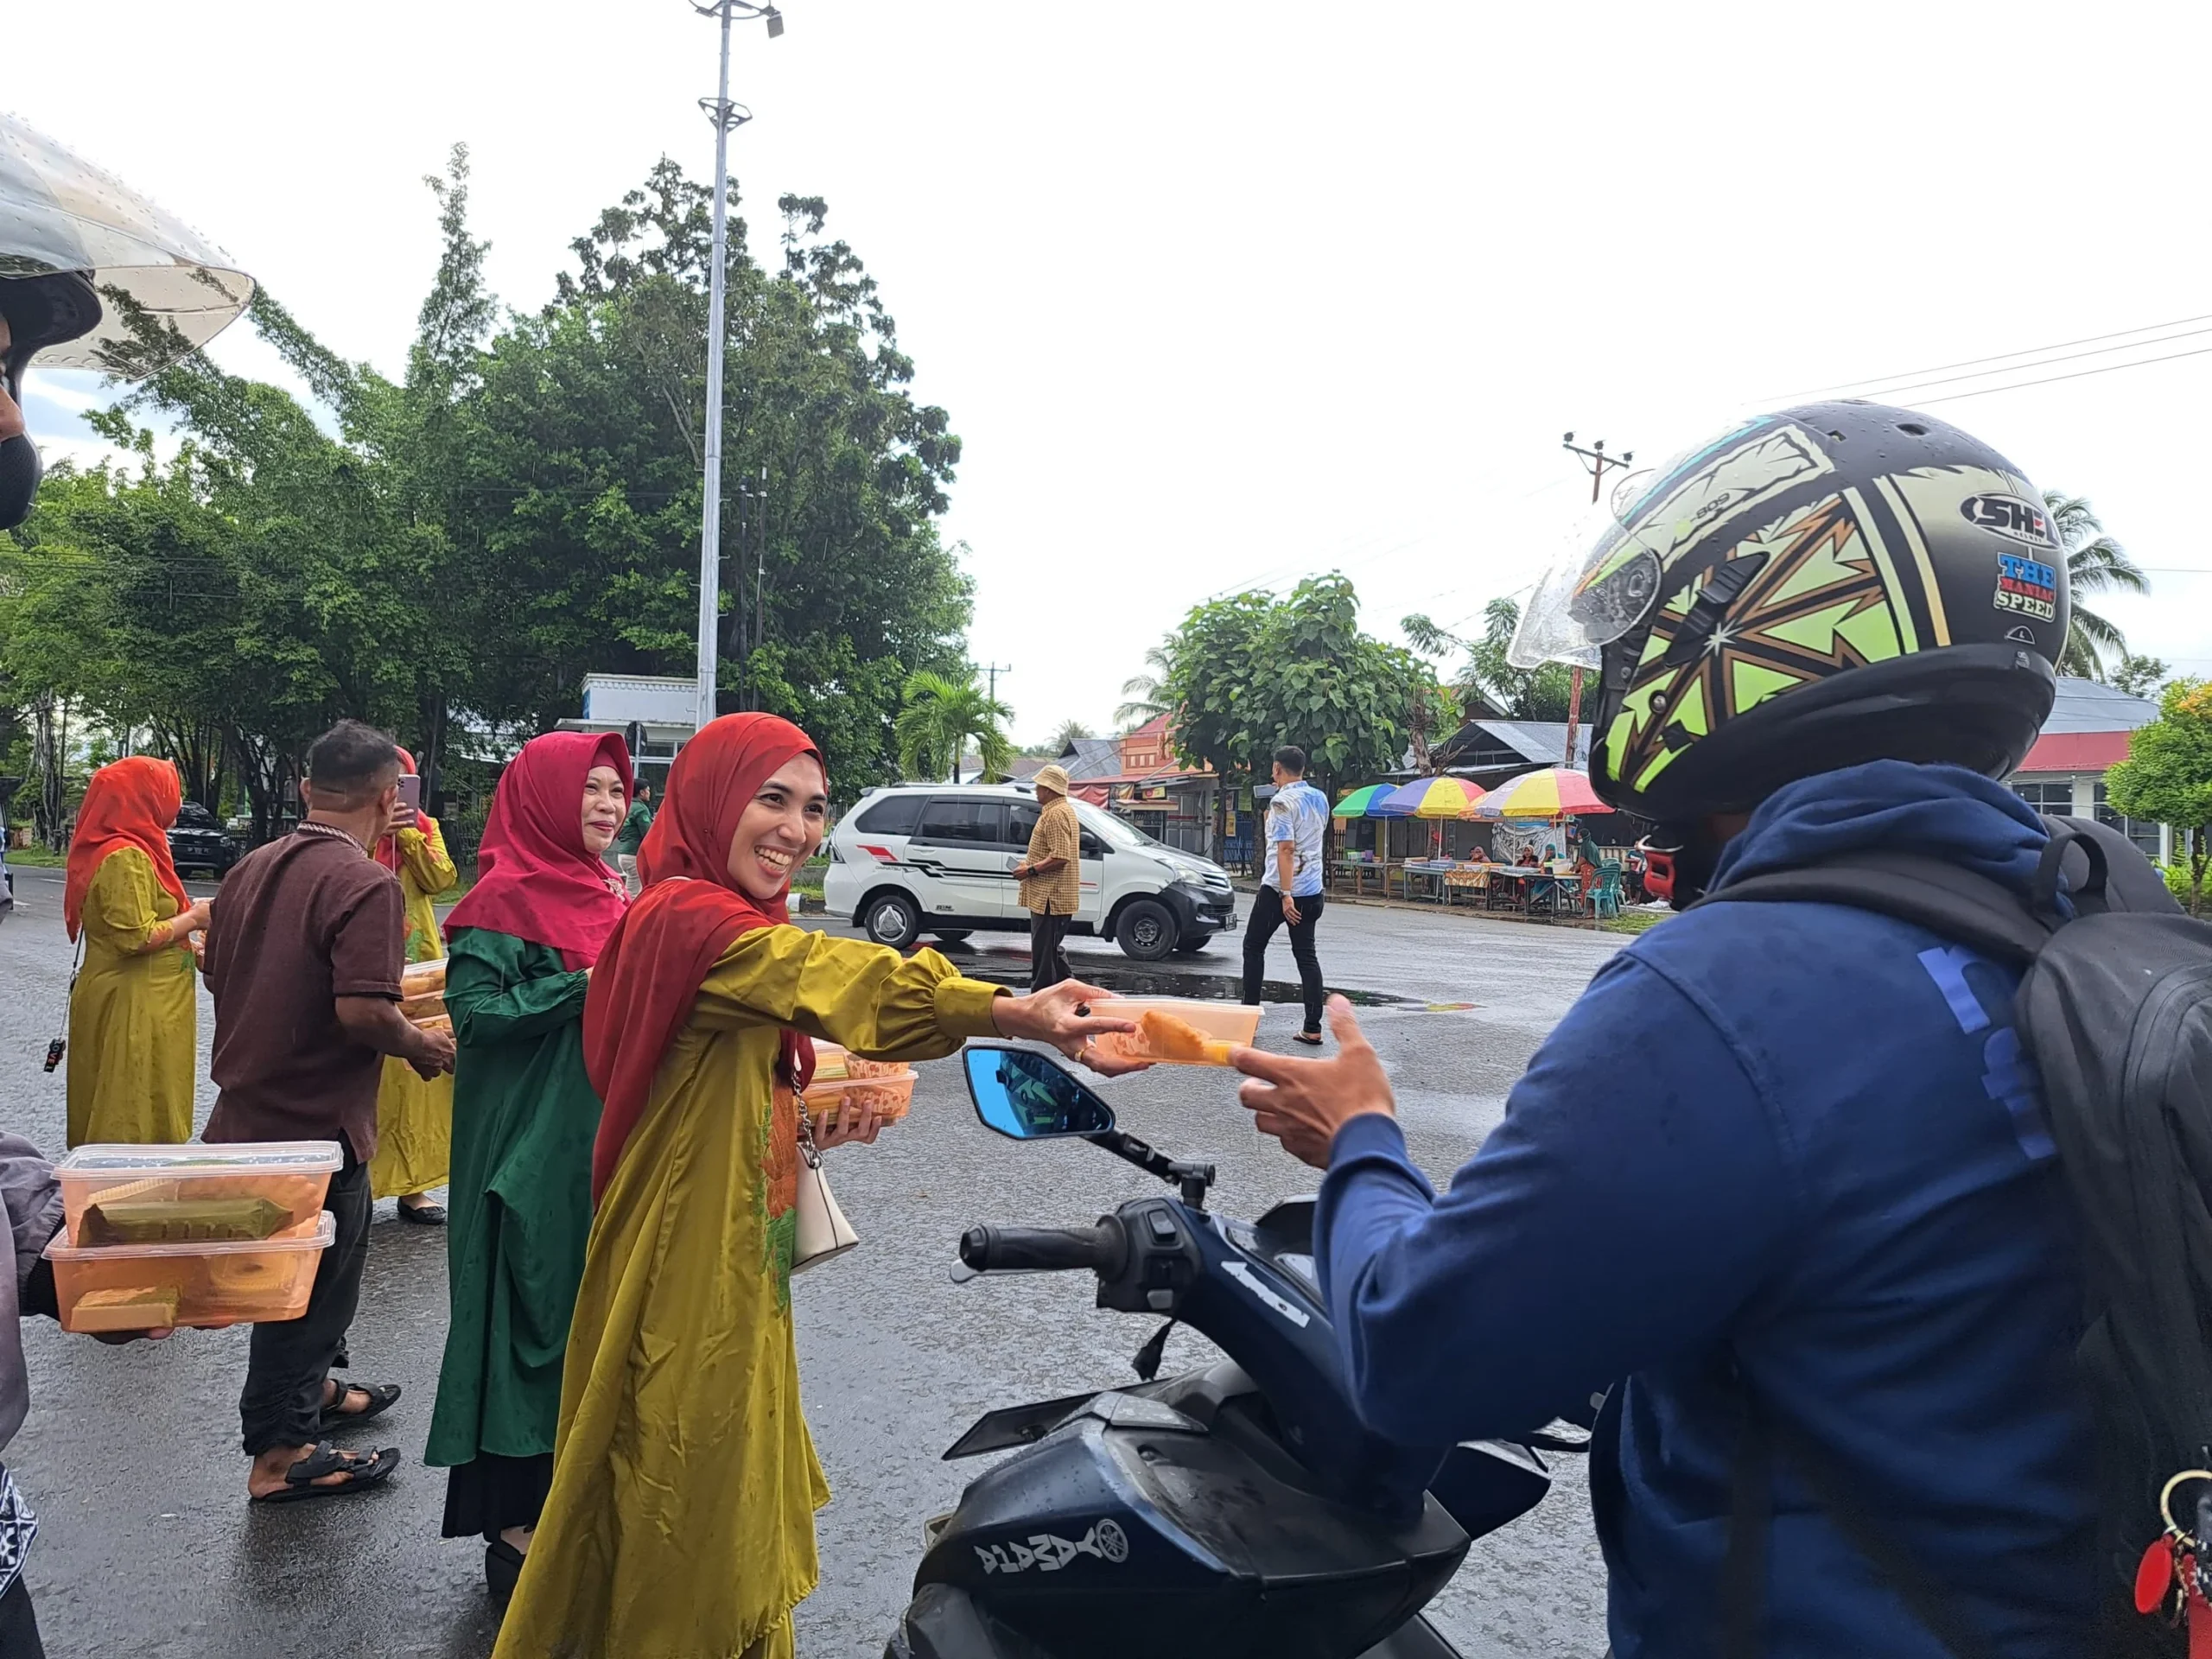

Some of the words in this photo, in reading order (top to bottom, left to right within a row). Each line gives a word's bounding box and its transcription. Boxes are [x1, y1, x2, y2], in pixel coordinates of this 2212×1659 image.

[1999, 554, 2055, 590] THE
[1999, 576, 2054, 602] MANIAC
[1996, 590, 2054, 619] SPEED
[2018, 630, 2025, 639] L
